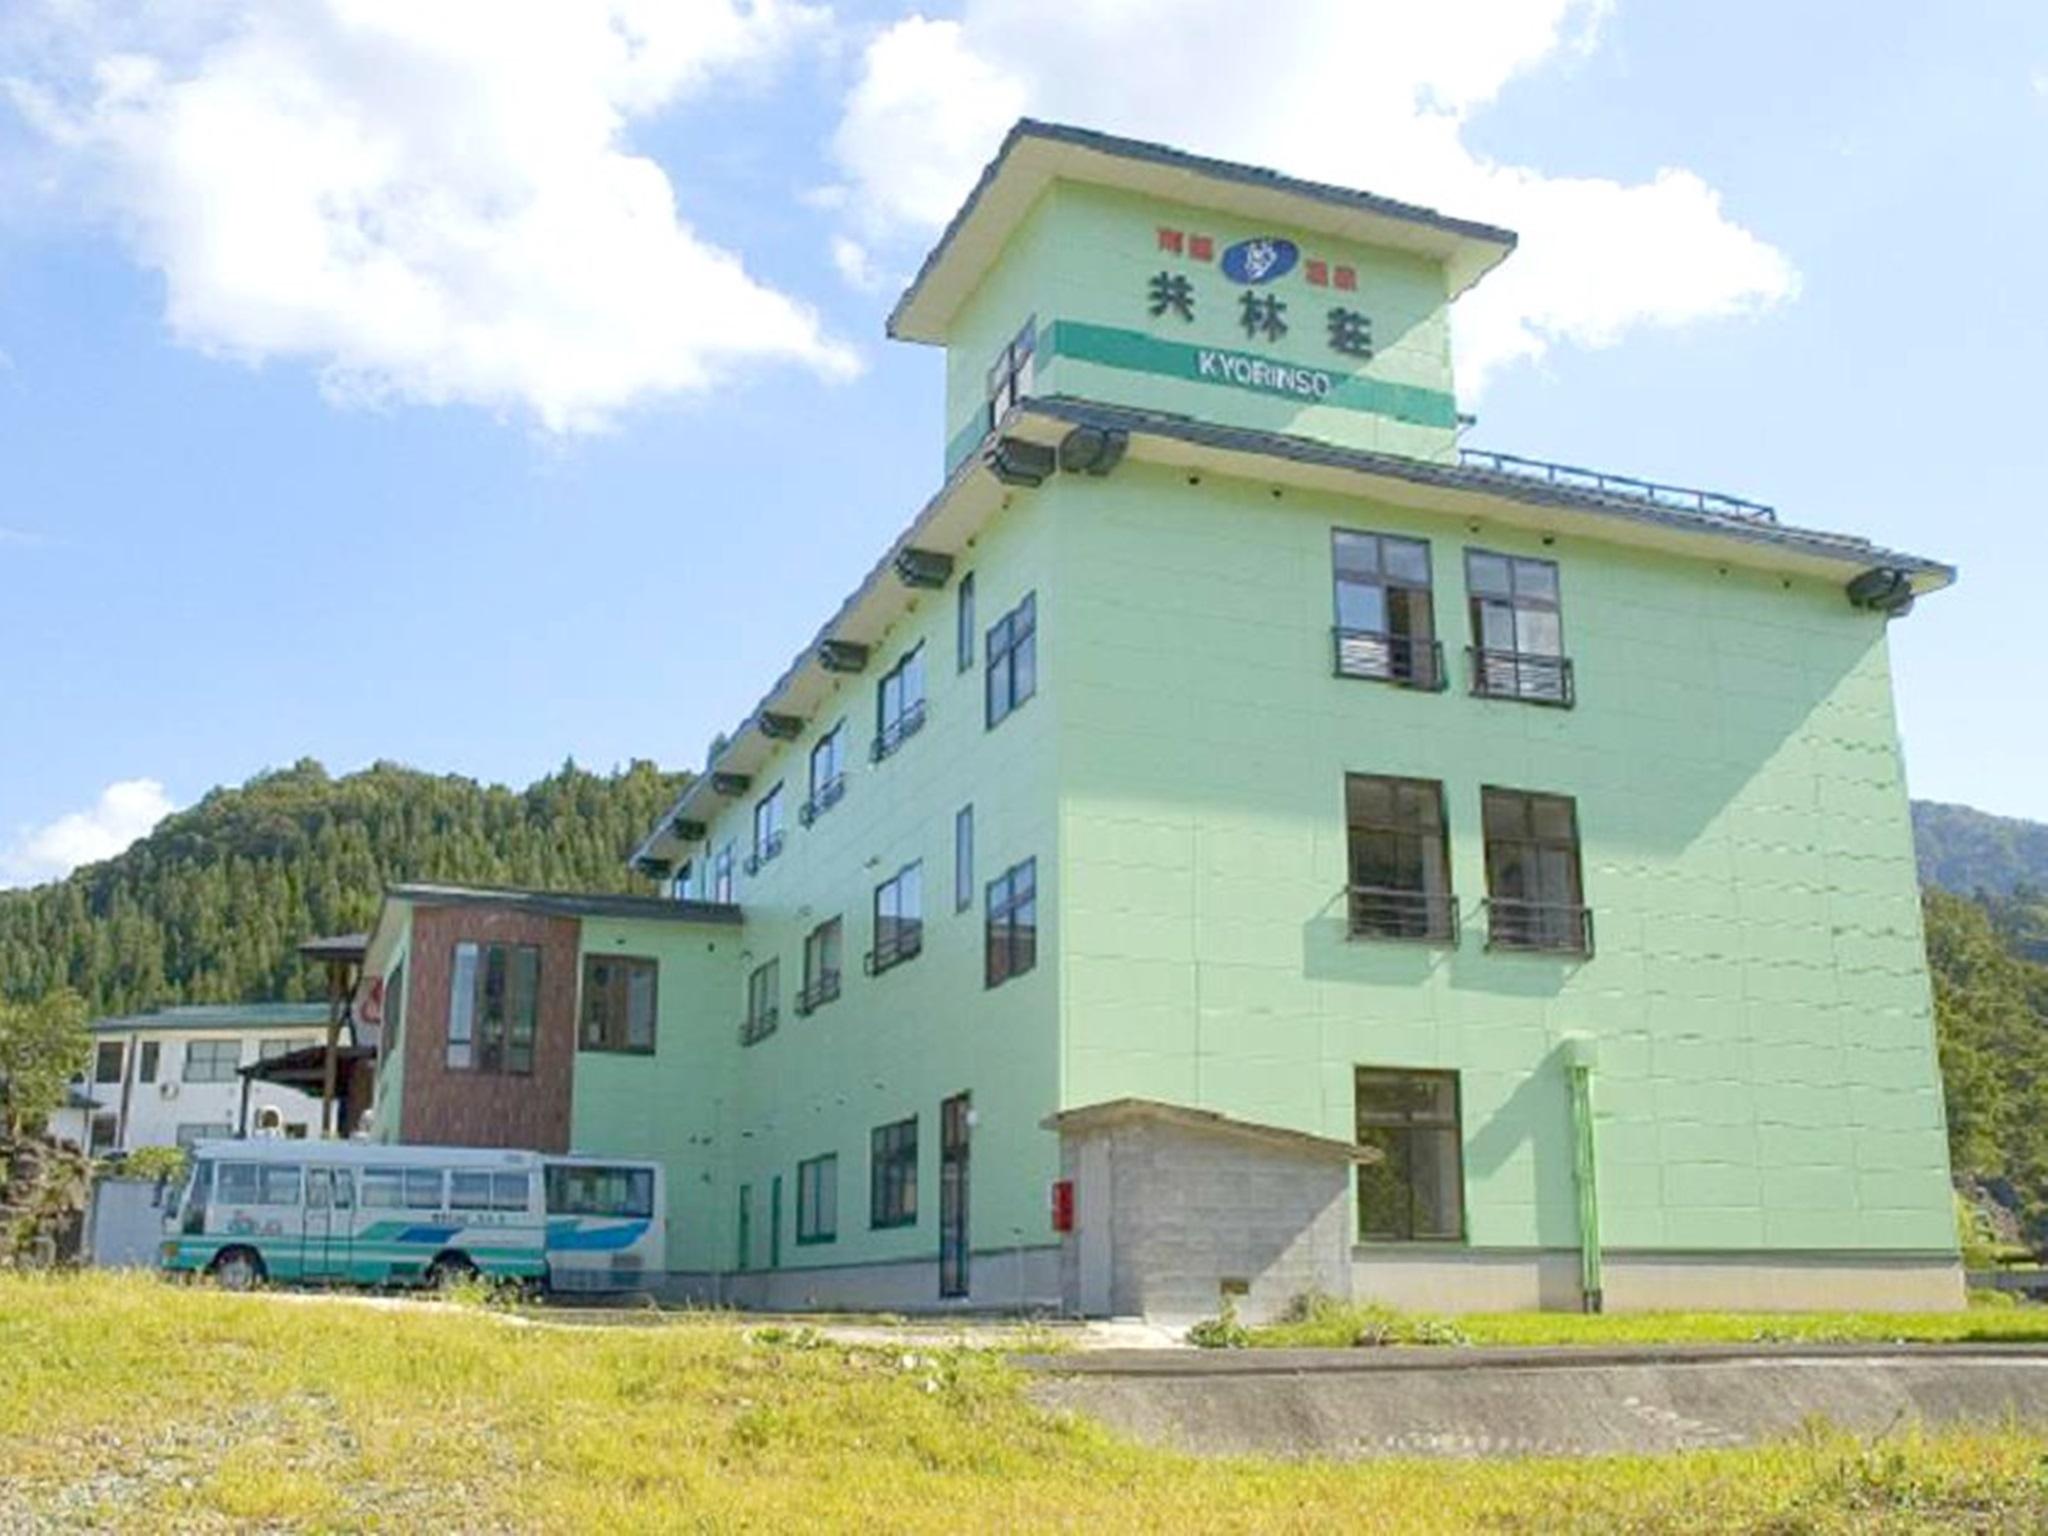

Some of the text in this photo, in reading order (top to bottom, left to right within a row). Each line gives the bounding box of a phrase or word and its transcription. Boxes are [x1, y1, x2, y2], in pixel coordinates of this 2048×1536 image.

[1149, 271, 1373, 359] 共林荘
[1199, 350, 1330, 397] KYORINSO
